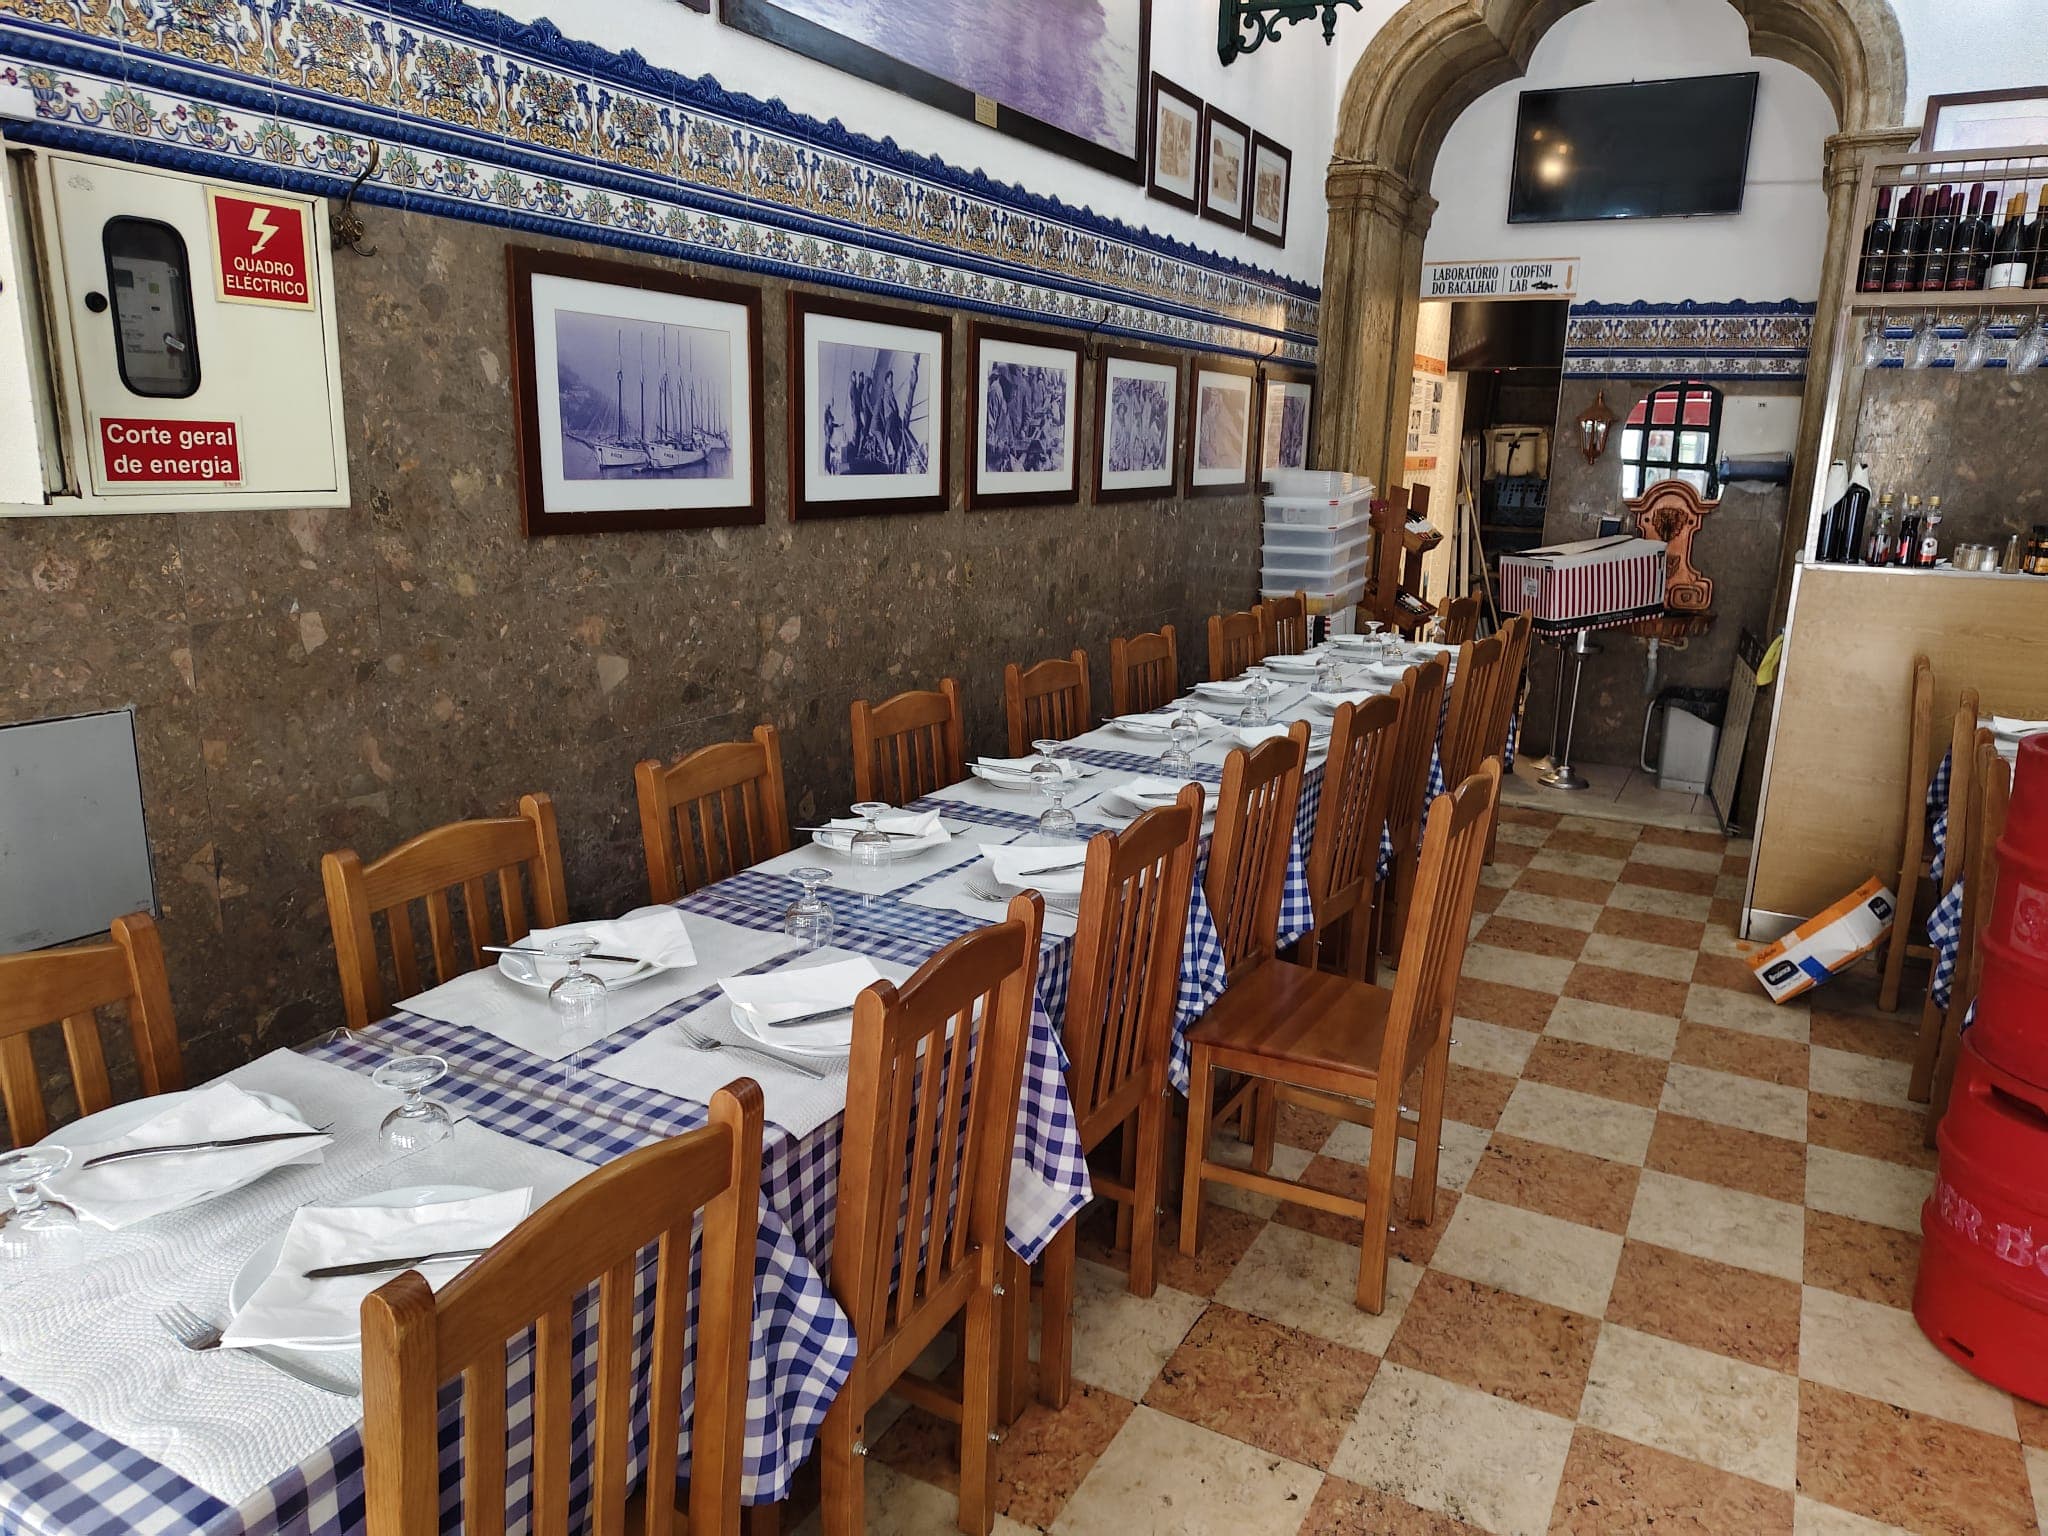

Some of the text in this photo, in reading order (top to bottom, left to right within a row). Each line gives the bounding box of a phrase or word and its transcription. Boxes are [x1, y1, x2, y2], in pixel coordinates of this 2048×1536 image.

[233, 256, 294, 277] QUADRO
[1433, 264, 1499, 281] LABORATÓRIO
[1510, 264, 1552, 279] CODFISH
[226, 272, 305, 296] ELÉCTRICO
[1431, 279, 1497, 295] DO BACALHAU
[1509, 279, 1528, 292] LAB
[106, 423, 233, 450] Corte geral
[113, 454, 233, 478] de energia
